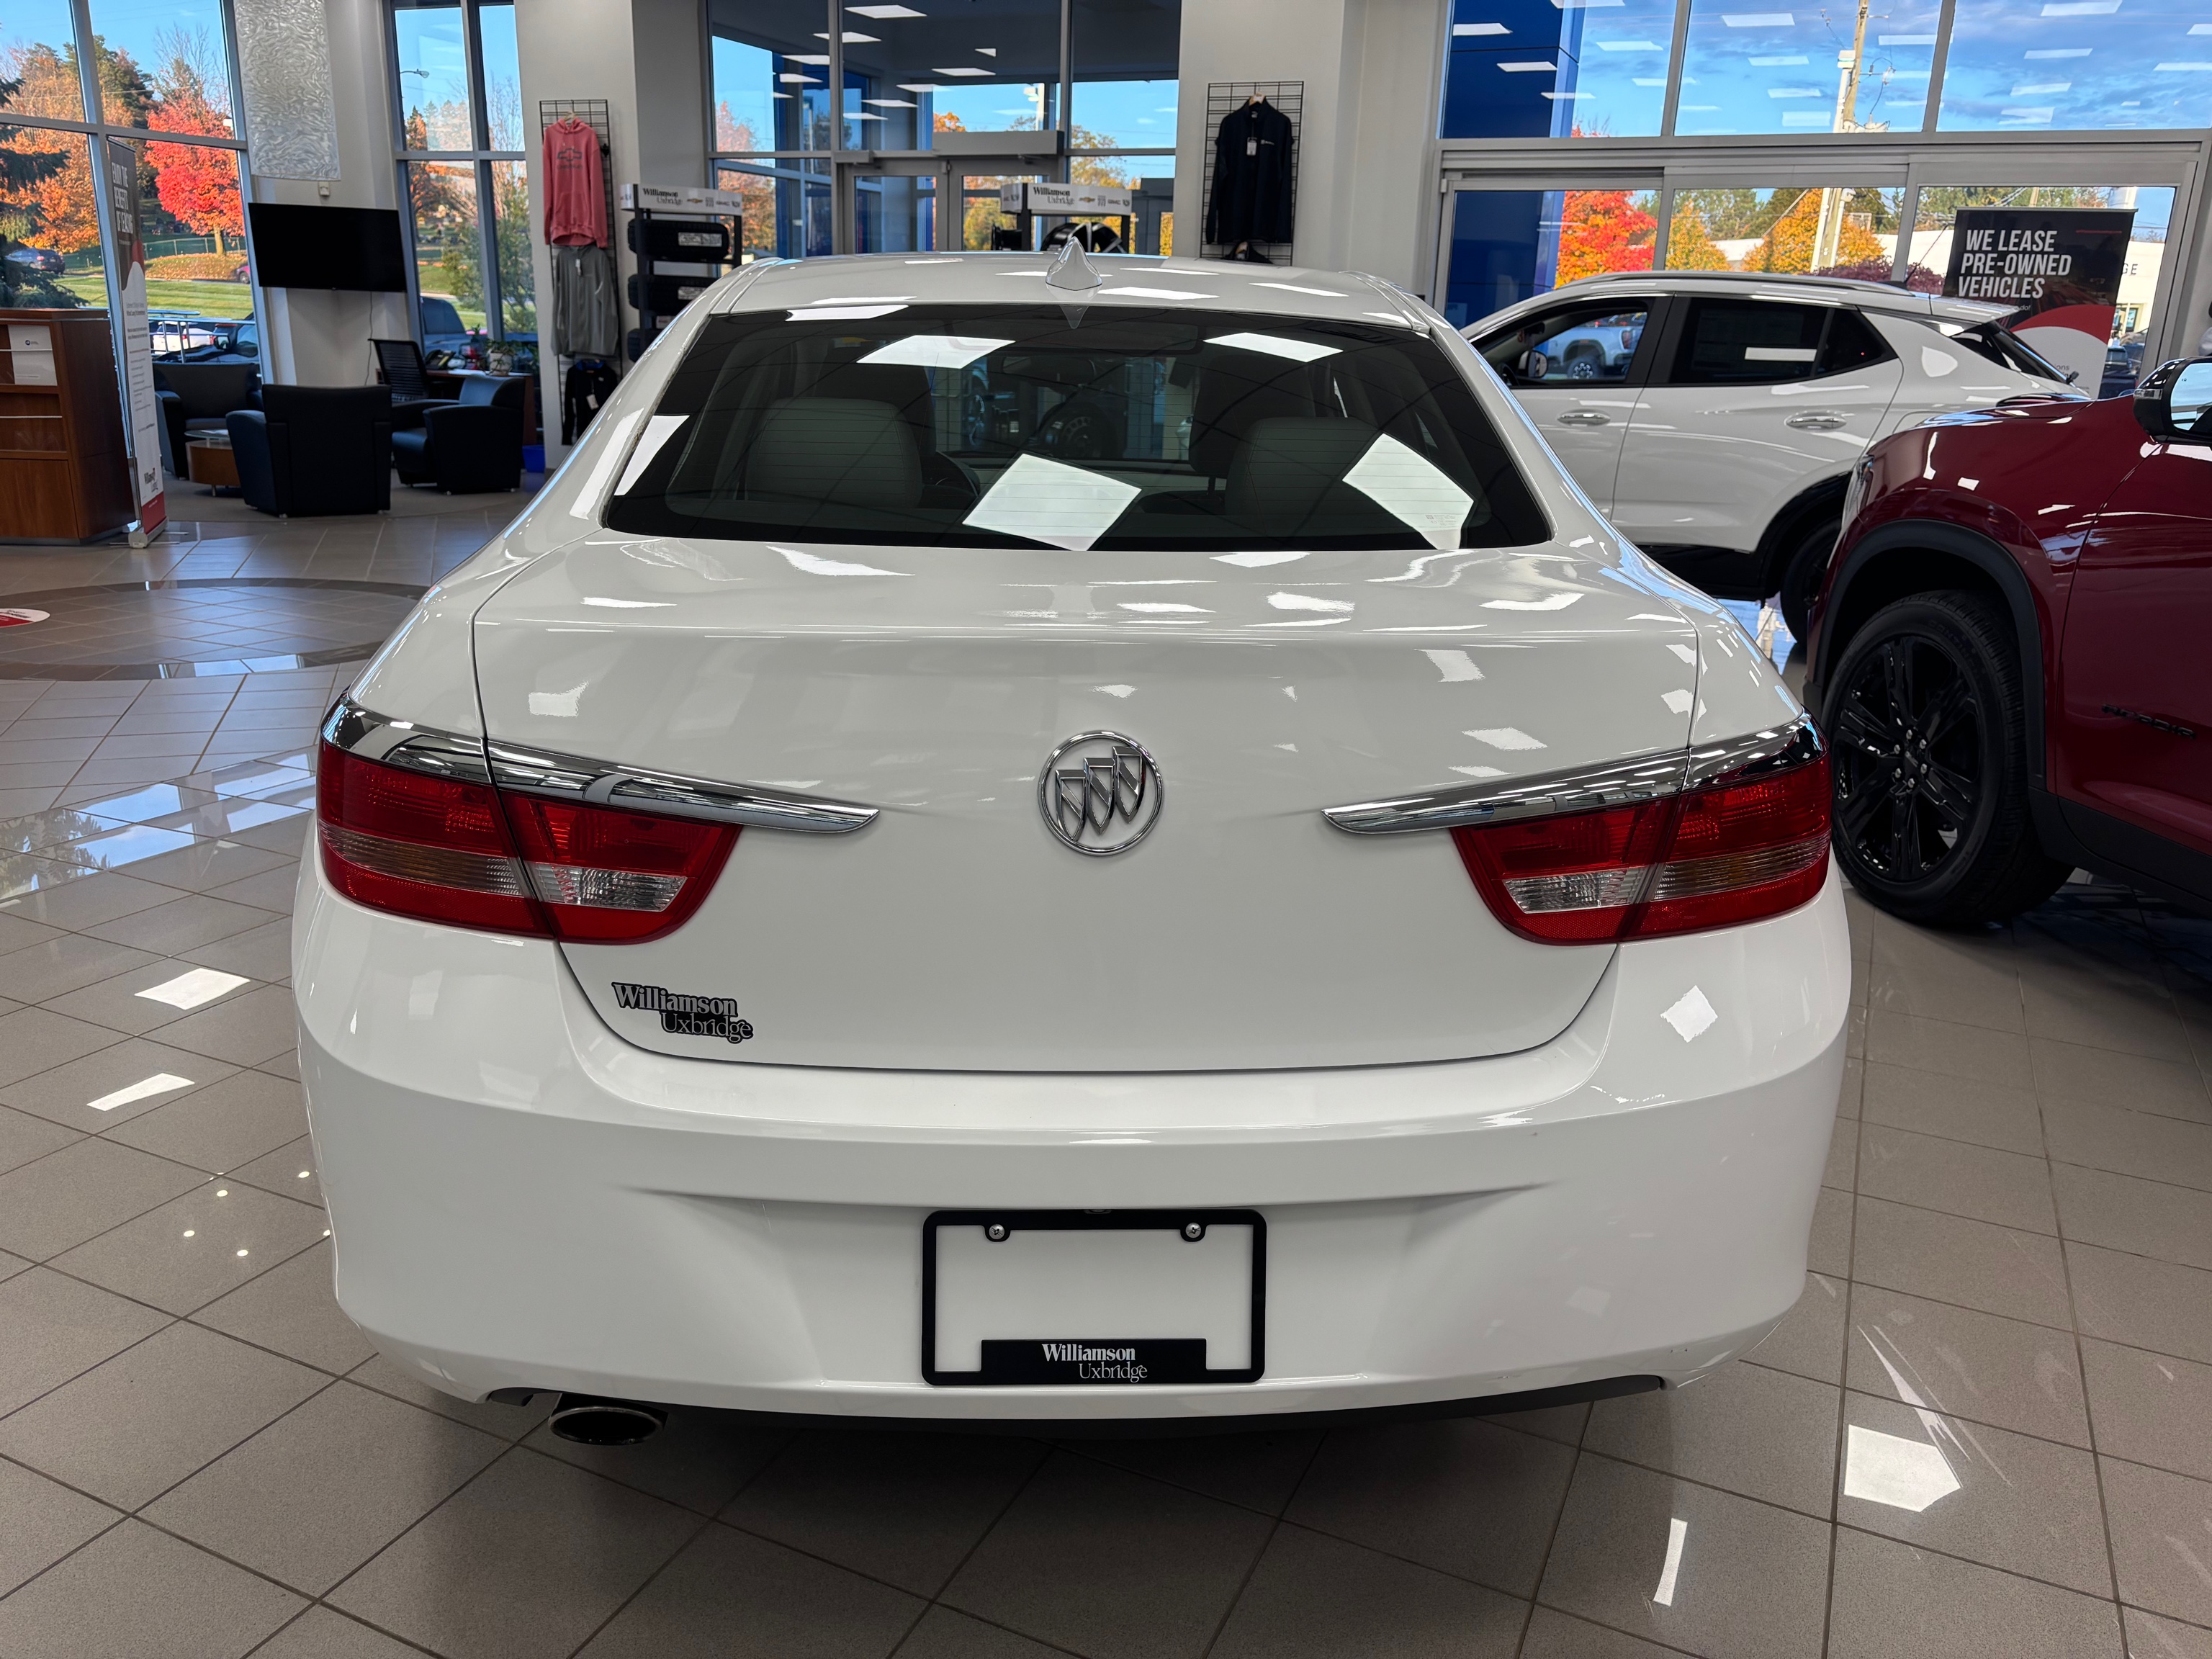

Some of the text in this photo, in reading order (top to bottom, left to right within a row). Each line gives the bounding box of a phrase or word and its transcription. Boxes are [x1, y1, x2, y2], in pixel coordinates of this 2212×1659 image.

[642, 187, 679, 197] Williamson
[1033, 186, 1071, 196] Williamson
[1966, 229, 2058, 252] WE LEASE
[1960, 253, 2072, 276] PRE-OWNED
[1958, 276, 2046, 299] VEHICLES
[612, 982, 738, 1017] Williamson
[660, 1012, 752, 1043] Uxbridge
[1041, 1343, 1136, 1362] Williamson
[1078, 1361, 1148, 1383] Uxbridge
